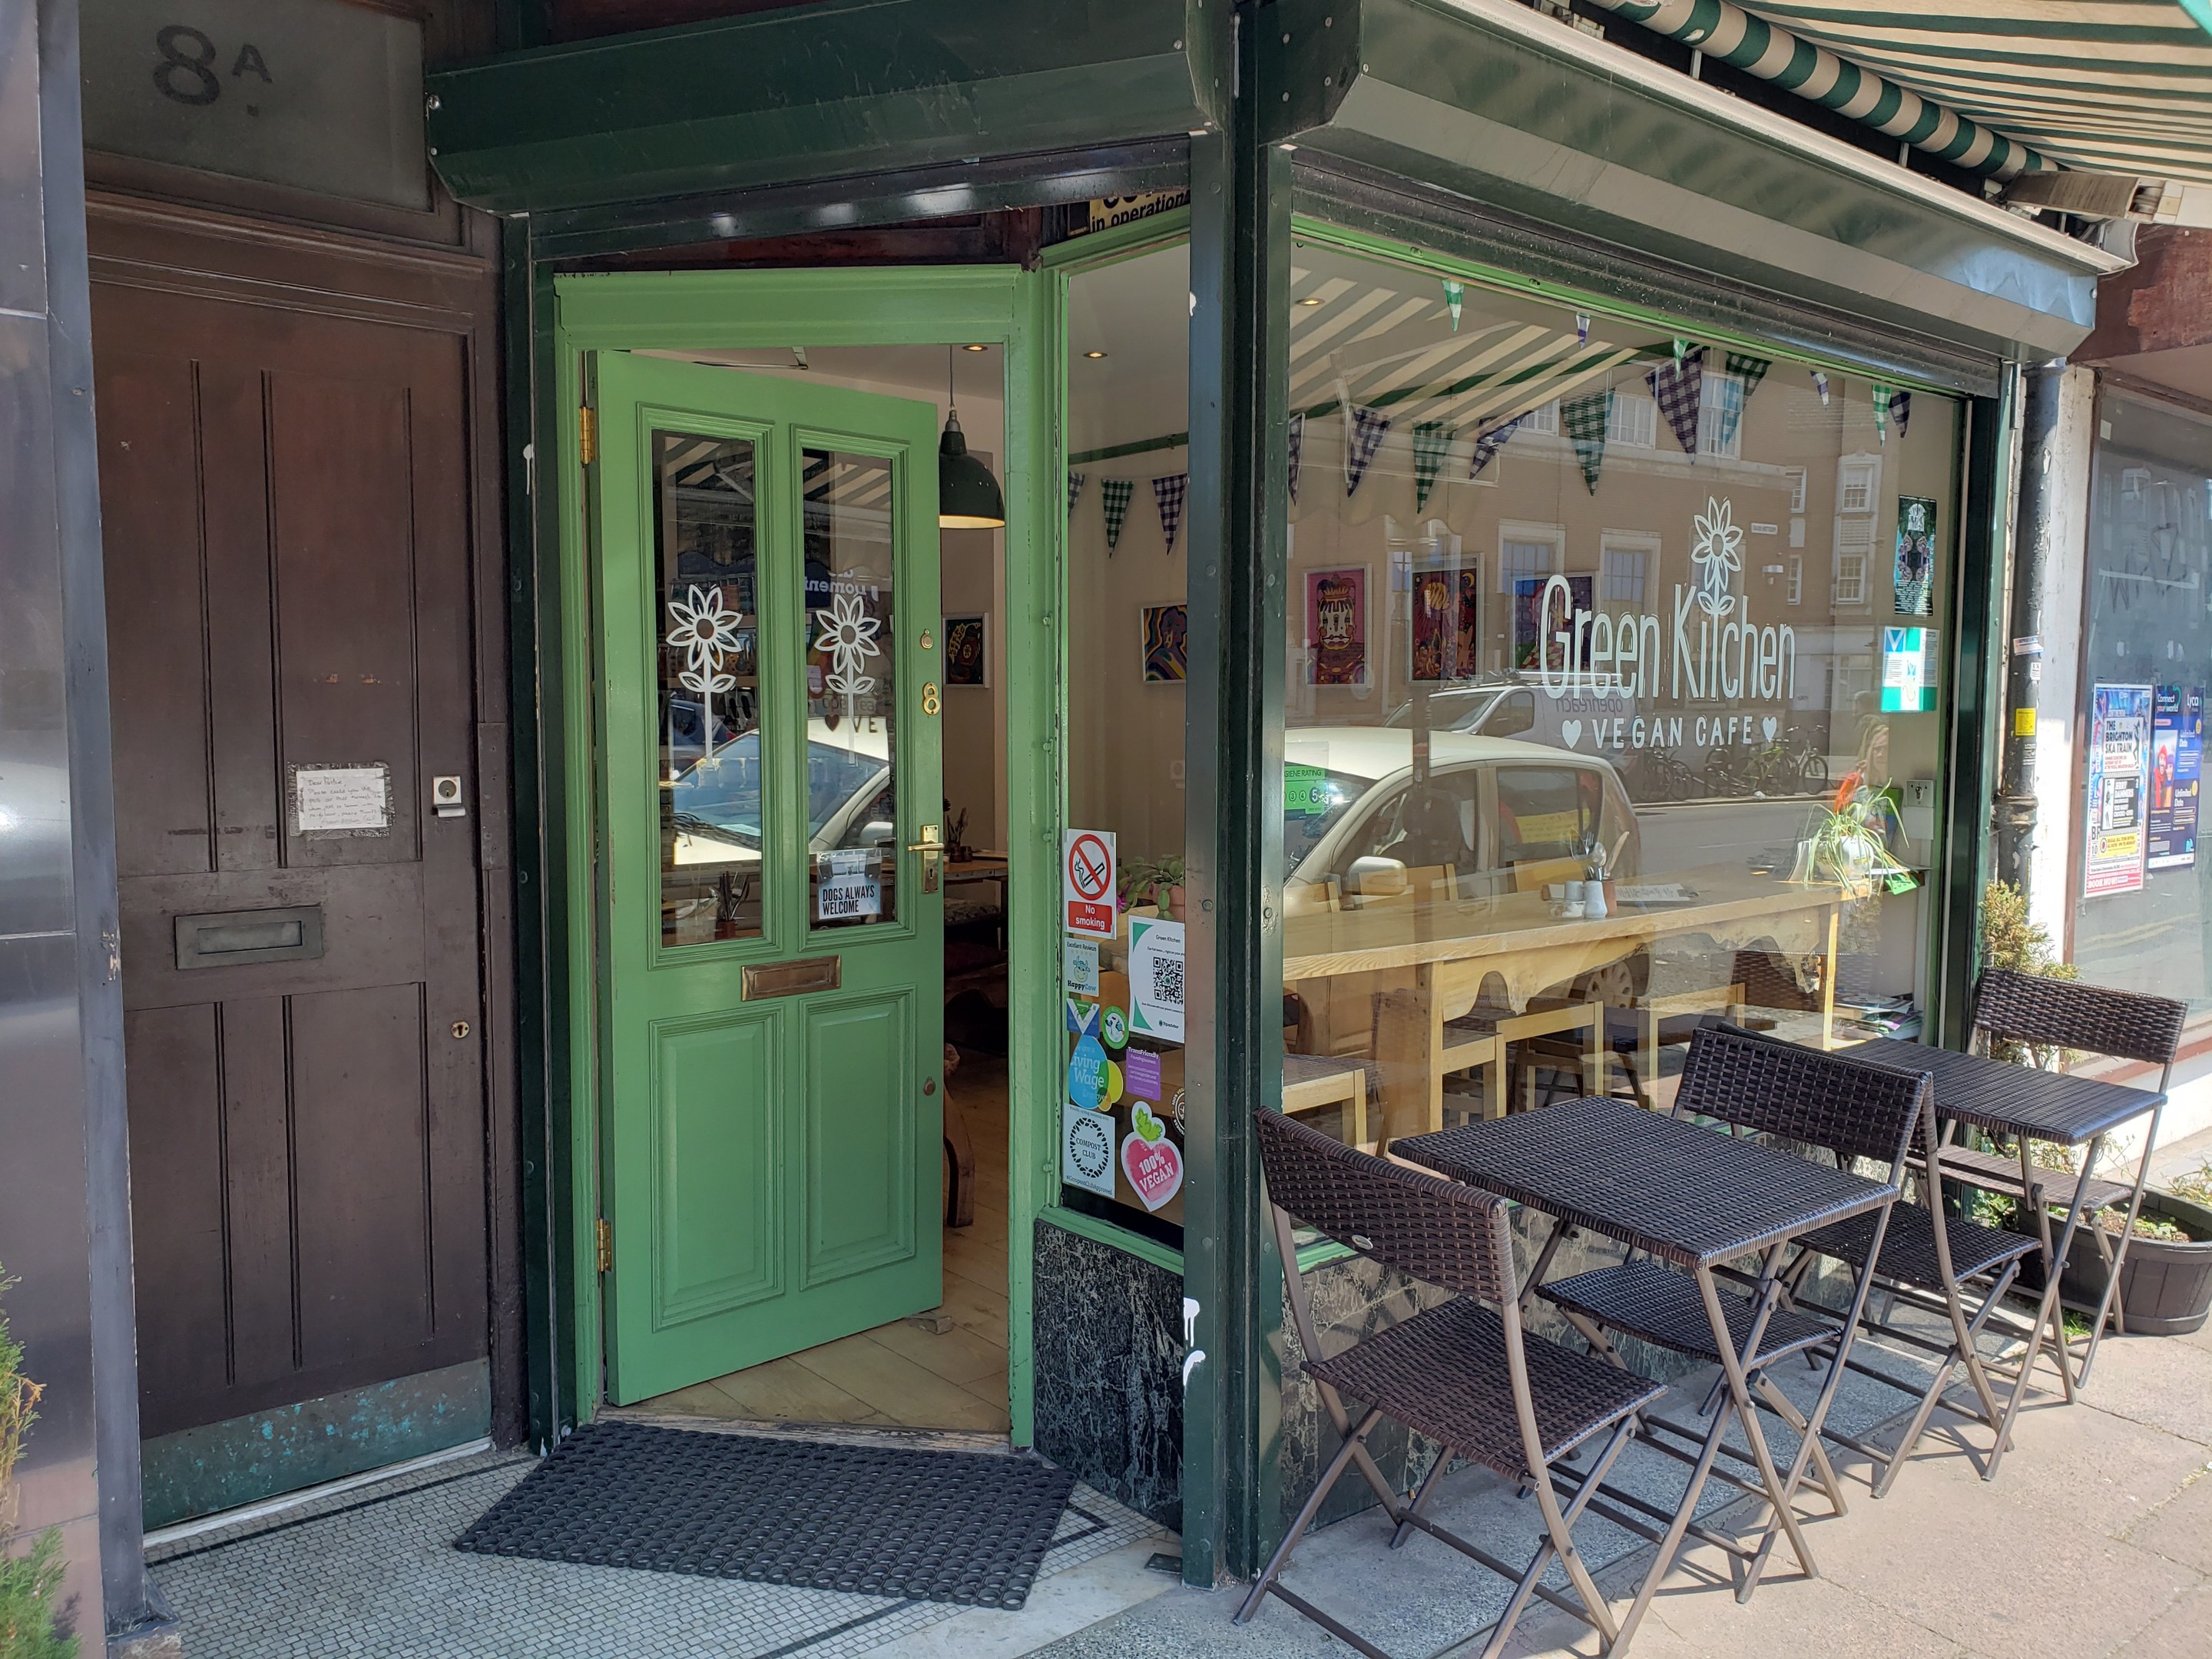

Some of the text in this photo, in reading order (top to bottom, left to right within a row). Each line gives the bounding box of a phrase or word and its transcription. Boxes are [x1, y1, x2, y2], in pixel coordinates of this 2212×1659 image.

[1091, 216, 1105, 233] in
[1540, 575, 1660, 700] Green
[1672, 583, 1795, 700] Kitchen
[923, 682, 940, 715] 8
[2157, 694, 2175, 703] Connect
[1591, 715, 1753, 749] VEGAN CAFE
[2106, 720, 2116, 730] THE
[2105, 731, 2133, 742] BRIGHTON
[2105, 743, 2132, 753] SKA TRAIN
[2088, 878, 2104, 889] BOOK
[823, 884, 875, 902] DOGS ALWAYS
[823, 899, 859, 916] WELCOME
[1085, 904, 1095, 914] No
[1075, 916, 1104, 930] smoking
[1067, 980, 1097, 992] HappyCow
[1073, 1067, 1104, 1090] Wage
[1075, 1137, 1101, 1151] COMPOST
[1082, 1149, 1096, 1159] CLUB
[1138, 1151, 1165, 1175] 100%
[1139, 1162, 1174, 1192] VEGAN
